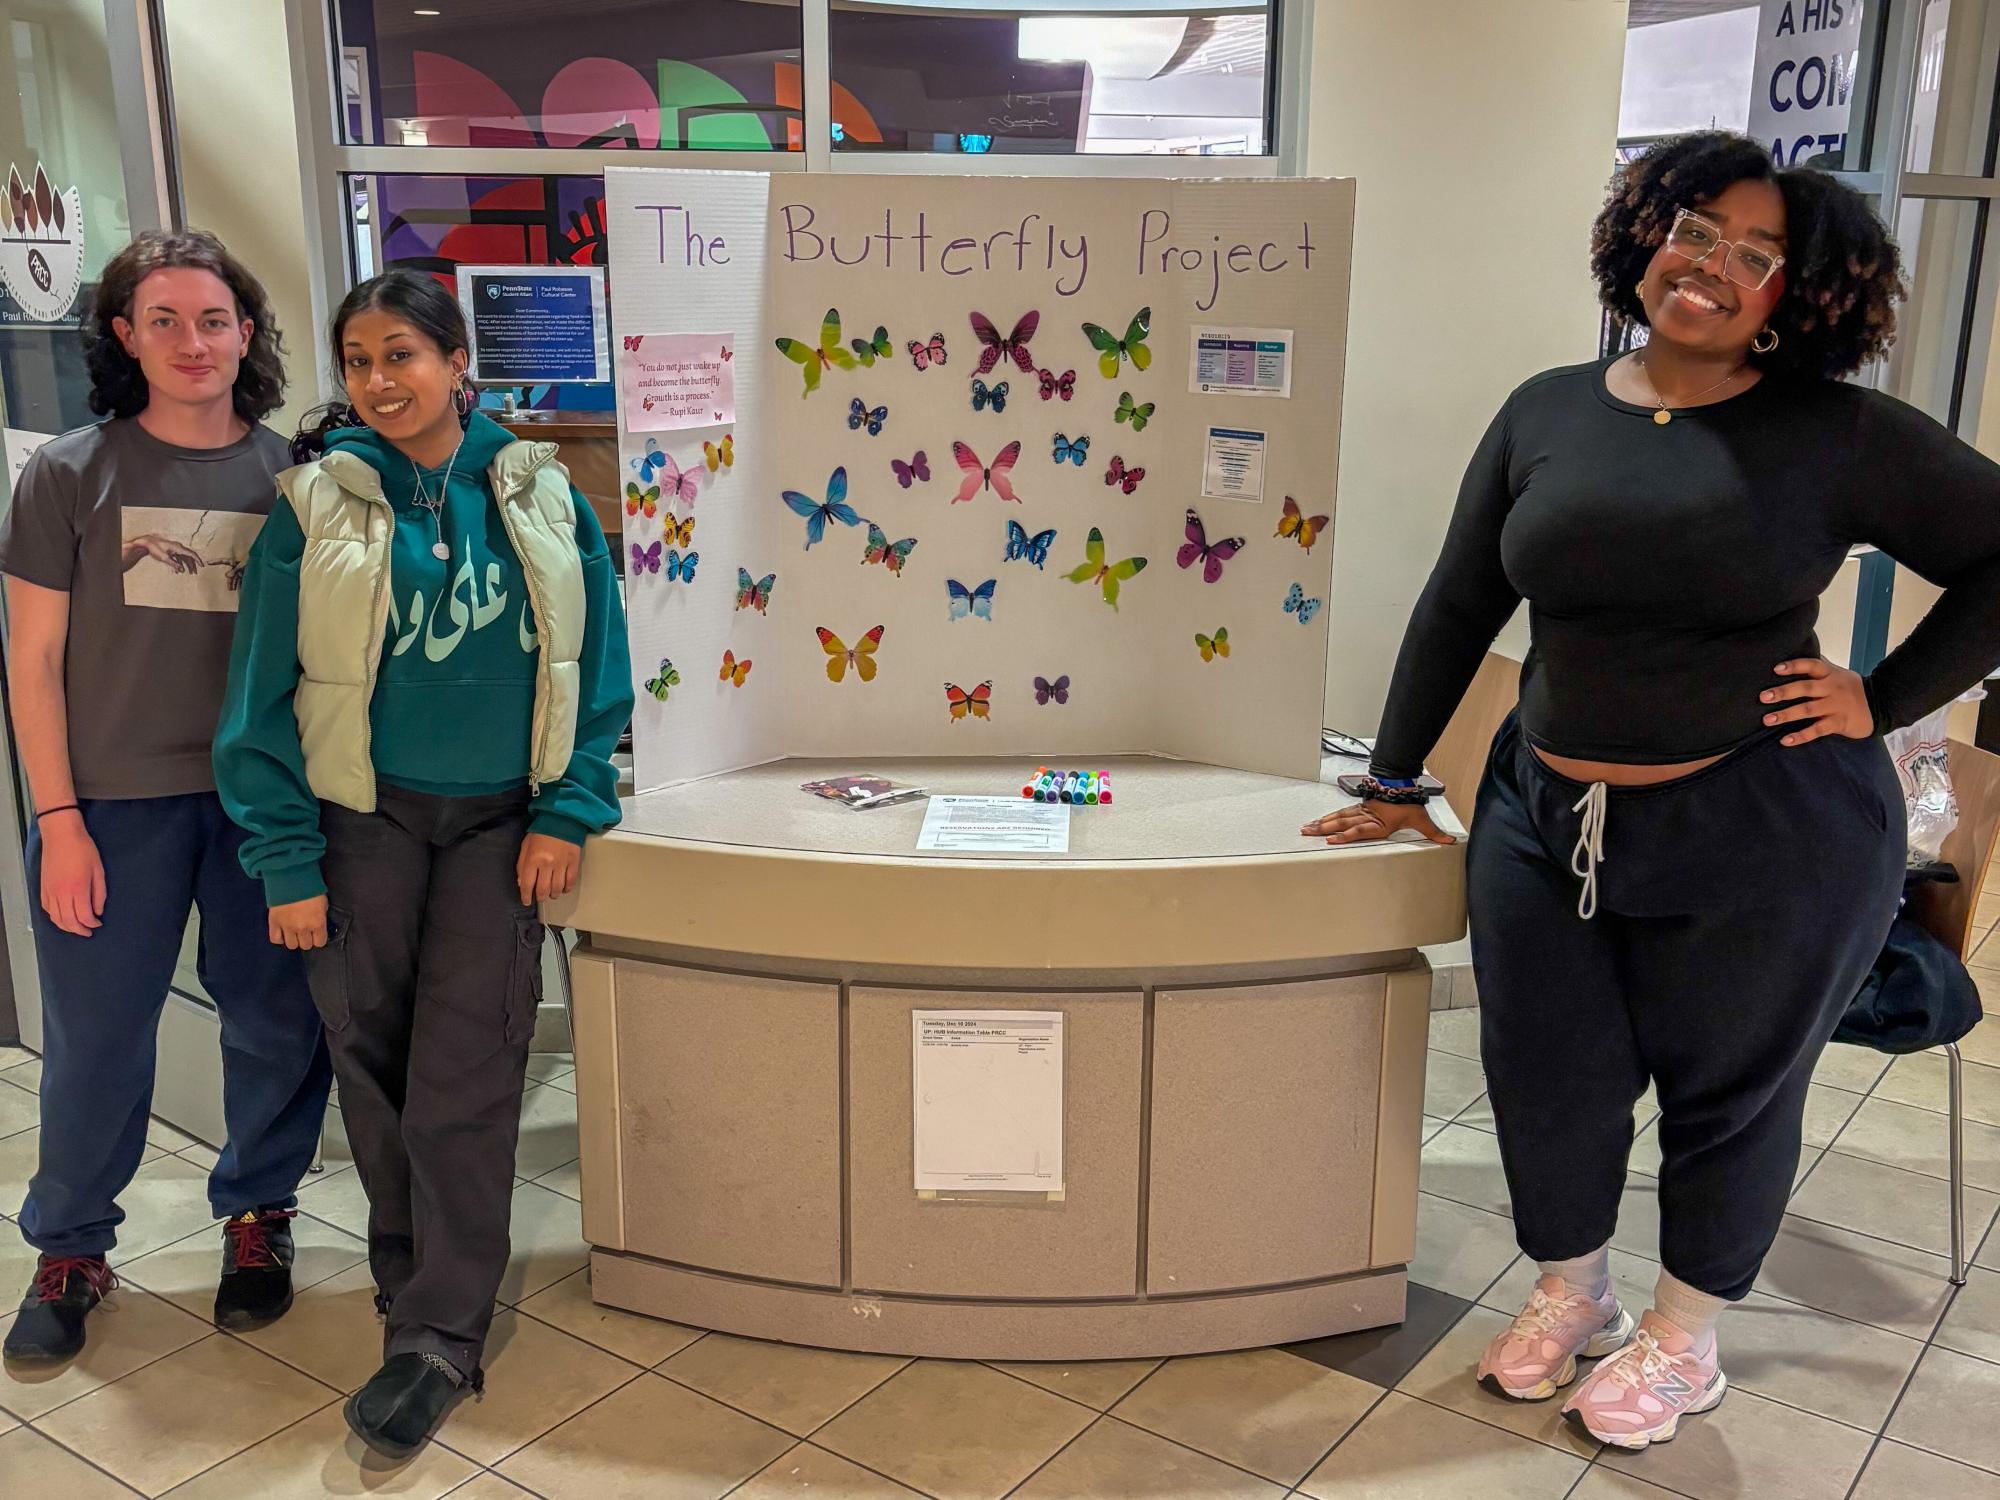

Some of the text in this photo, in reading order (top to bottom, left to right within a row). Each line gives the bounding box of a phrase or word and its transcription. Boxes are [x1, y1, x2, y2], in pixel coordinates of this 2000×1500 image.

[1776, 0, 1845, 37] A HIS
[30, 254, 48, 288] PRCC
[635, 204, 1316, 311] The Butterfly Project
[638, 378, 652, 387] and
[680, 377, 690, 386] the
[657, 362, 665, 371] do
[666, 362, 677, 371] not
[678, 362, 692, 373] just
[693, 361, 711, 370] wake
[712, 362, 720, 372] up
[646, 392, 672, 402] Growth
[673, 393, 679, 401] is
[1650, 1371, 1695, 1408] N
